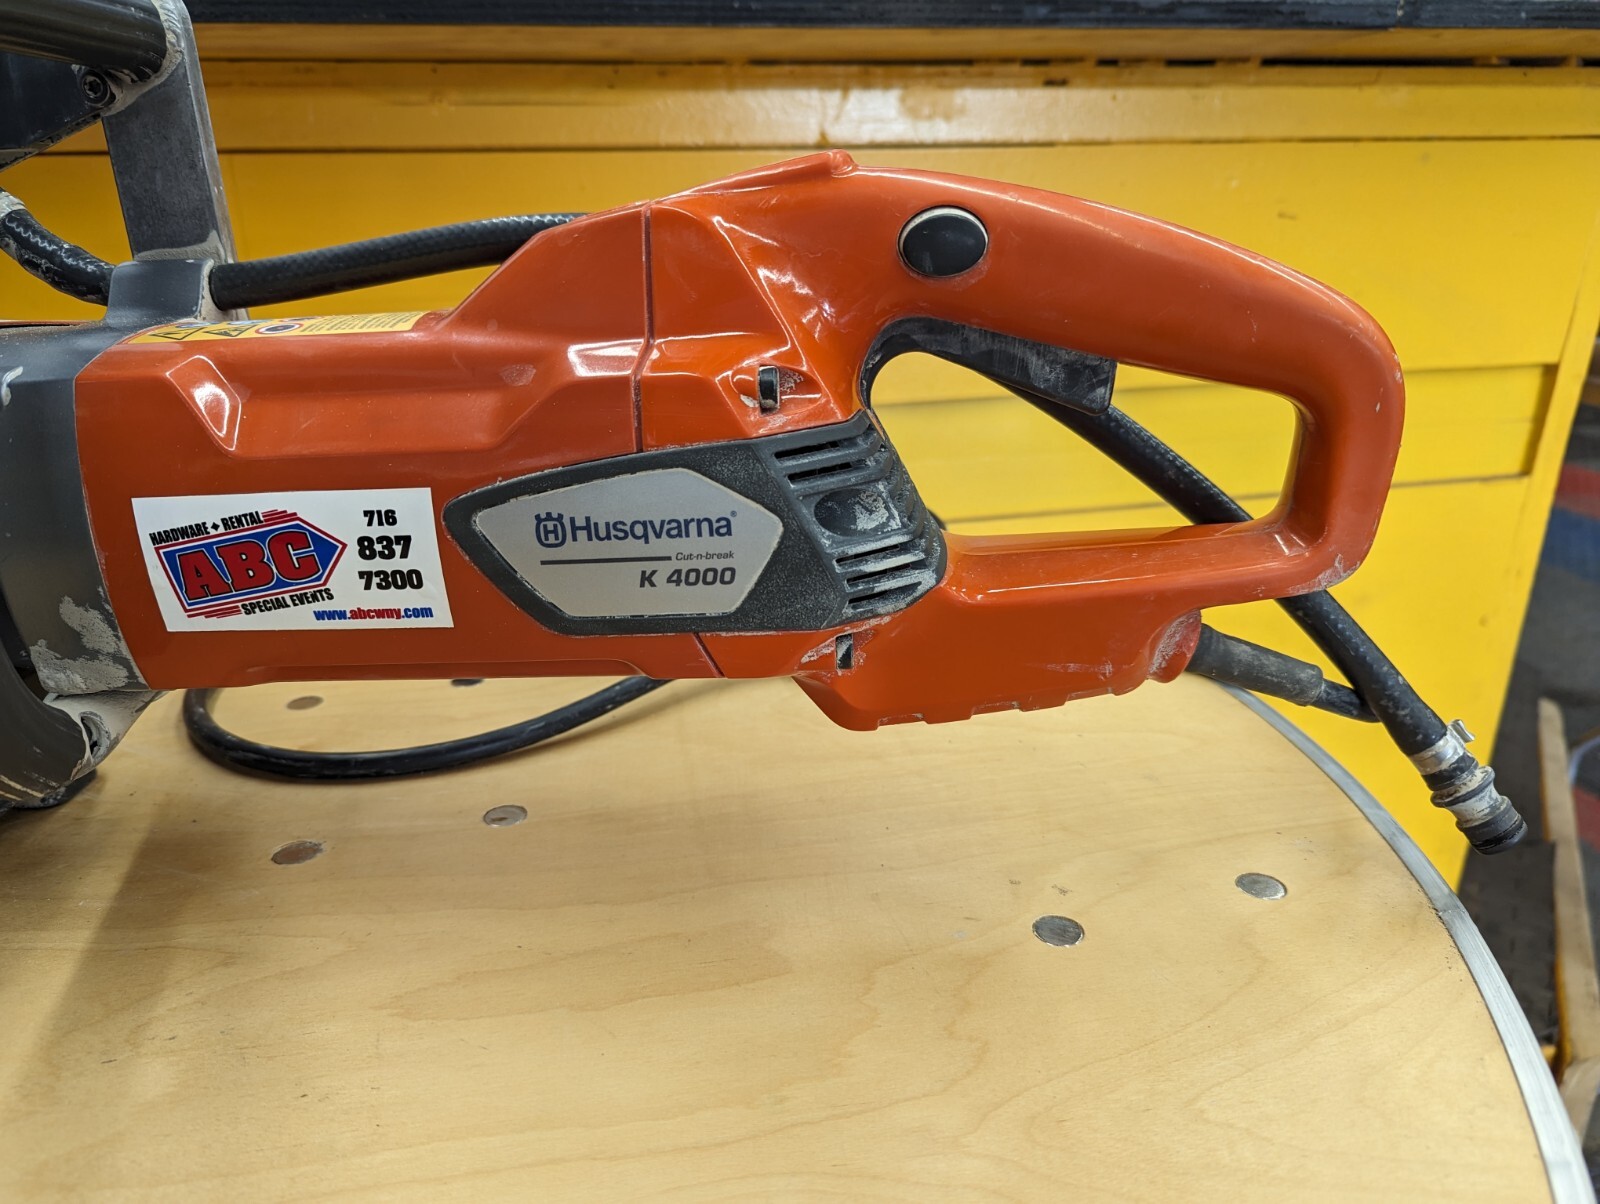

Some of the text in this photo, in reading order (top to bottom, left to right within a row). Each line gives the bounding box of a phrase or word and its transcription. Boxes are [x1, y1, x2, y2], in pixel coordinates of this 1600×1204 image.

[363, 509, 398, 527] 716
[149, 511, 263, 547] HARDWARE RENTAL
[357, 535, 412, 560] 837
[675, 551, 735, 561] Cut-n-break
[178, 531, 321, 601] ABC
[358, 569, 424, 590] 7300
[639, 567, 737, 588] K 4000
[242, 588, 334, 615] SPECIAL EVENTS
[313, 607, 434, 621] www.abcwny.com
